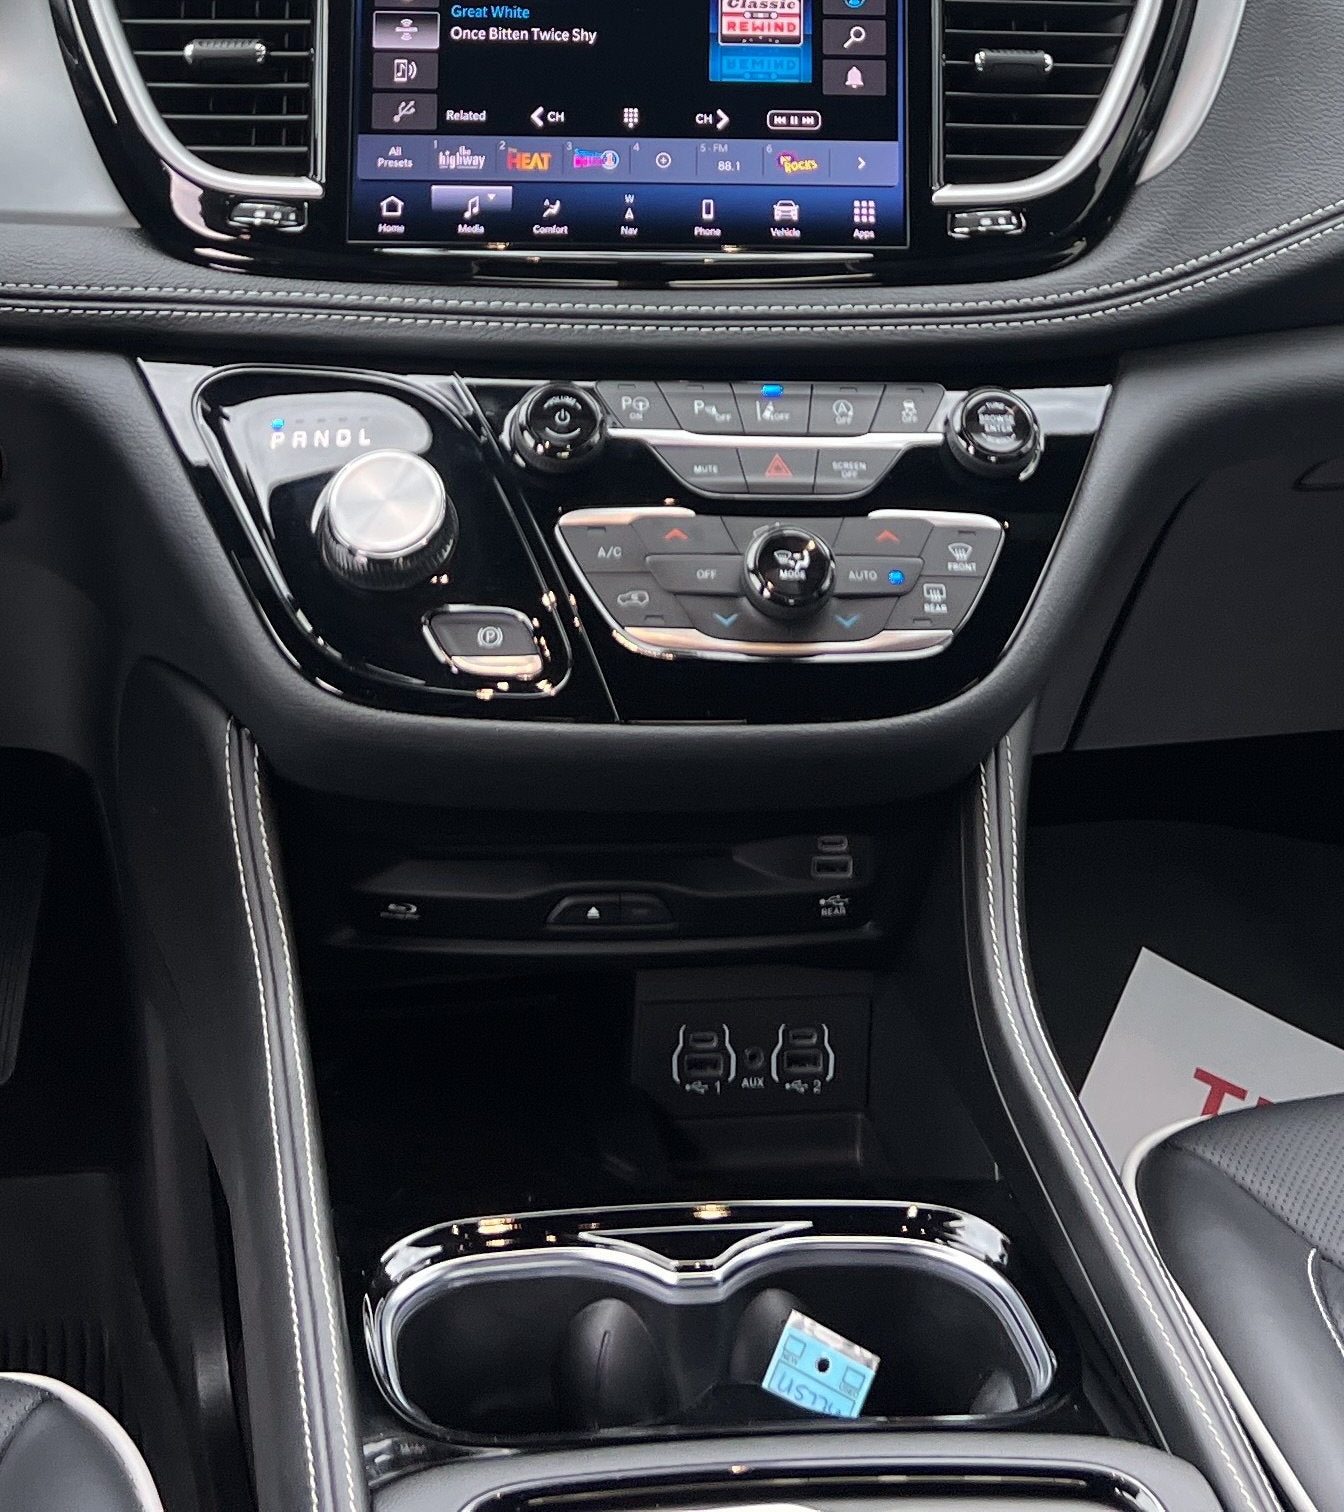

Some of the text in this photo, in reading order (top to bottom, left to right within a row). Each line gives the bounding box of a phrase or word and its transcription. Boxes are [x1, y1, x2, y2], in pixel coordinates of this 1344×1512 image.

[451, 4, 530, 19] Great White
[726, 21, 797, 33] REWIND
[450, 26, 597, 44] Once Bitten Twice Shy
[446, 110, 487, 122] Related
[547, 112, 565, 123] CH
[695, 114, 713, 125] CH
[499, 141, 506, 150] 2
[566, 141, 573, 150] 3
[633, 143, 640, 151] 4
[700, 144, 728, 153] 5 FM
[766, 144, 773, 153] 6
[389, 146, 402, 157] All
[377, 158, 413, 169] Presets
[439, 151, 486, 169] highway
[507, 152, 553, 172] HEAT
[718, 161, 740, 171] 88.1
[378, 224, 405, 234] Home
[458, 224, 485, 234] Media
[533, 224, 568, 235] Comfort
[620, 225, 638, 235] Nav
[694, 226, 721, 237] Phone
[770, 227, 801, 238] Vehicle
[853, 228, 875, 240] Apps
[835, 416, 852, 425] OFF
[693, 464, 718, 473] MUTE
[832, 461, 867, 471] SCREEN
[841, 469, 858, 478] OFF
[597, 546, 622, 558] A/C
[947, 562, 977, 573] FRONT
[696, 570, 717, 580] OFF
[779, 569, 806, 581] MODE
[848, 571, 878, 582] AUTO
[924, 603, 947, 613] REAR
[821, 907, 846, 917] REAR
[741, 1077, 765, 1089] AUX
